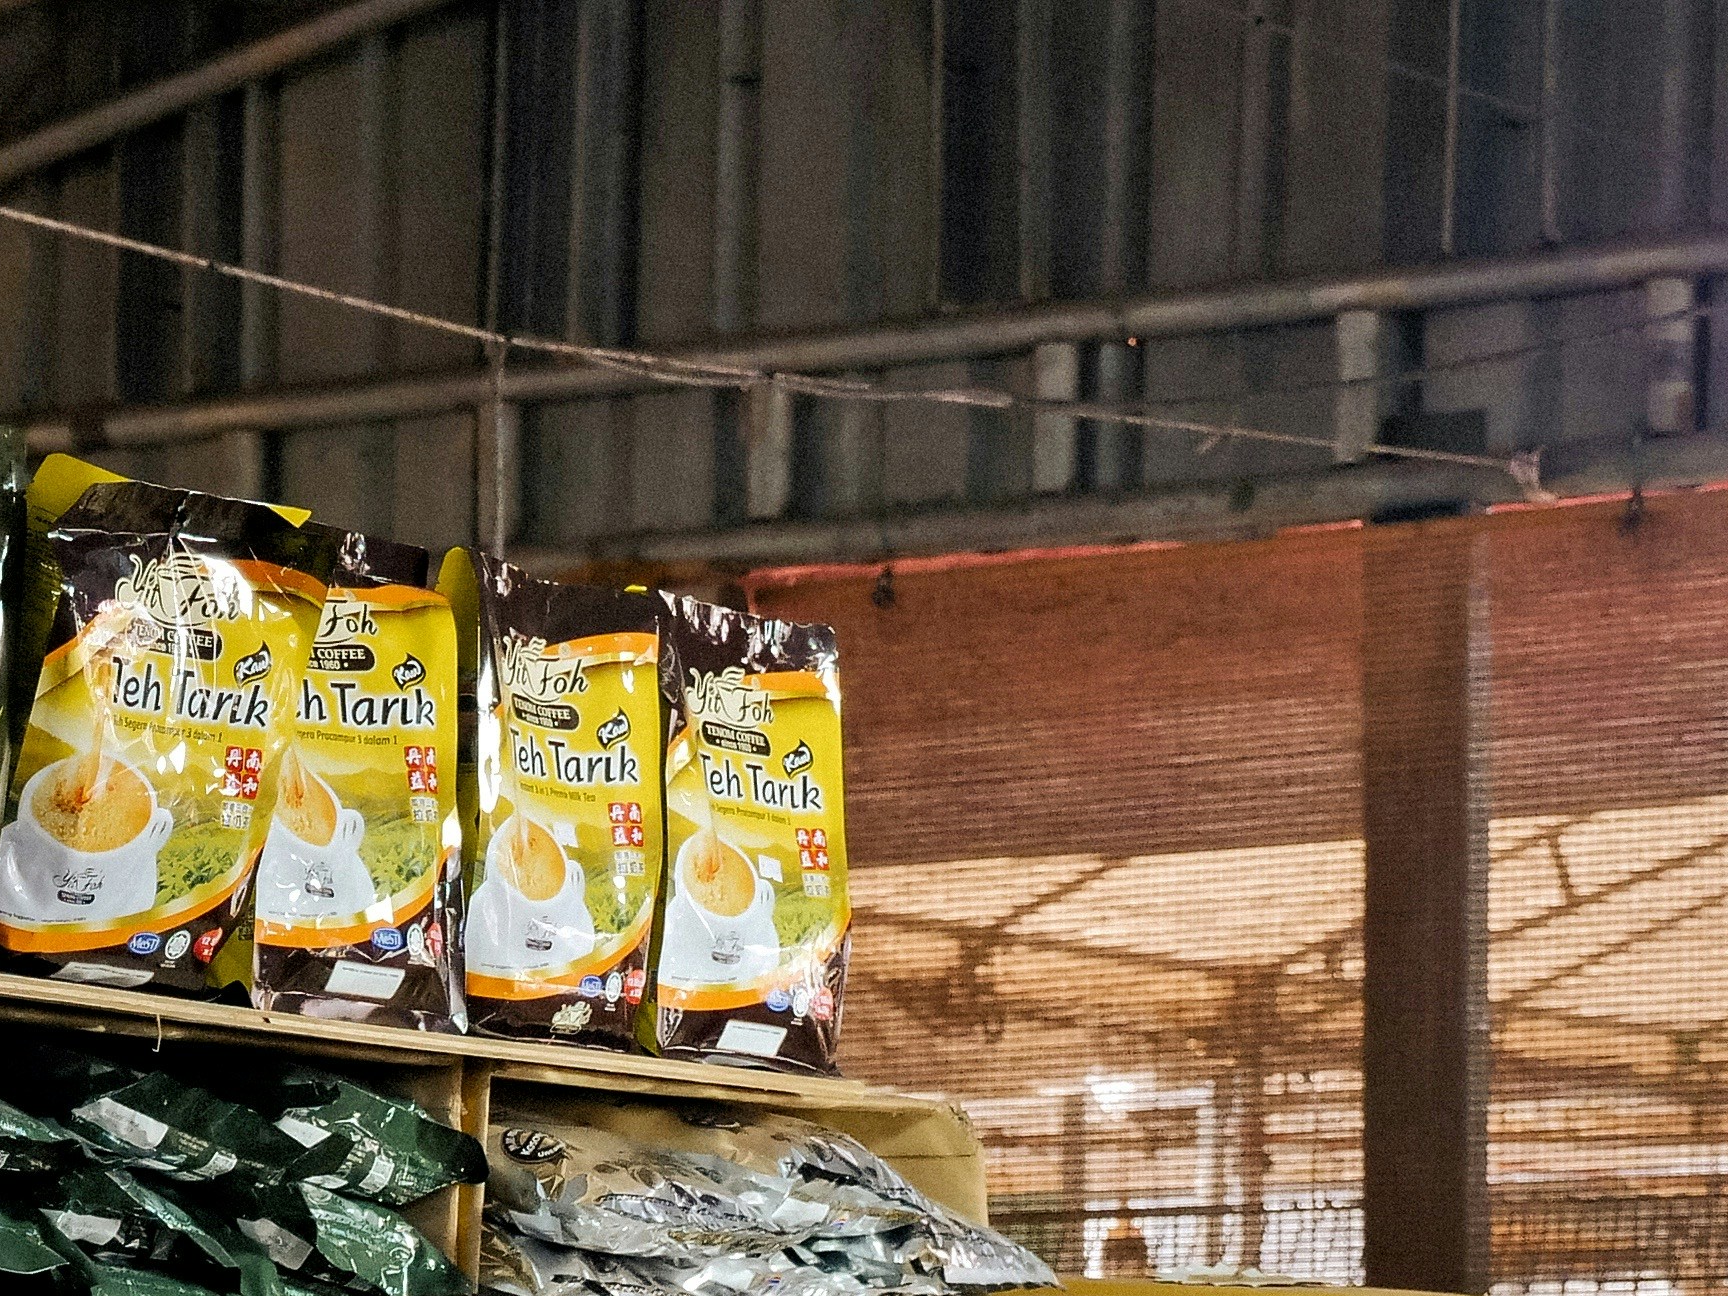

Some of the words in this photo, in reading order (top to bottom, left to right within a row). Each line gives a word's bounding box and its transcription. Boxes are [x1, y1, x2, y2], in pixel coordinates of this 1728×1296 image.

[236, 650, 270, 681] Kaw
[316, 648, 366, 660] COFFEE
[320, 659, 340, 670] 1960
[395, 660, 422, 684] Kaw
[537, 658, 588, 696] Foh
[112, 656, 161, 711] Teh
[176, 669, 269, 727] Tarik
[330, 682, 435, 727] Tarik
[537, 705, 571, 720] COFFEE
[733, 687, 774, 725] Foh
[599, 715, 628, 741] Kaw
[706, 725, 734, 741] TENOM
[736, 732, 766, 747] COFFEE
[510, 728, 546, 778] Teh
[547, 740, 638, 783] Tarik
[784, 747, 811, 772] Kaw
[699, 754, 743, 800] Teh
[746, 764, 822, 810] Tarik
